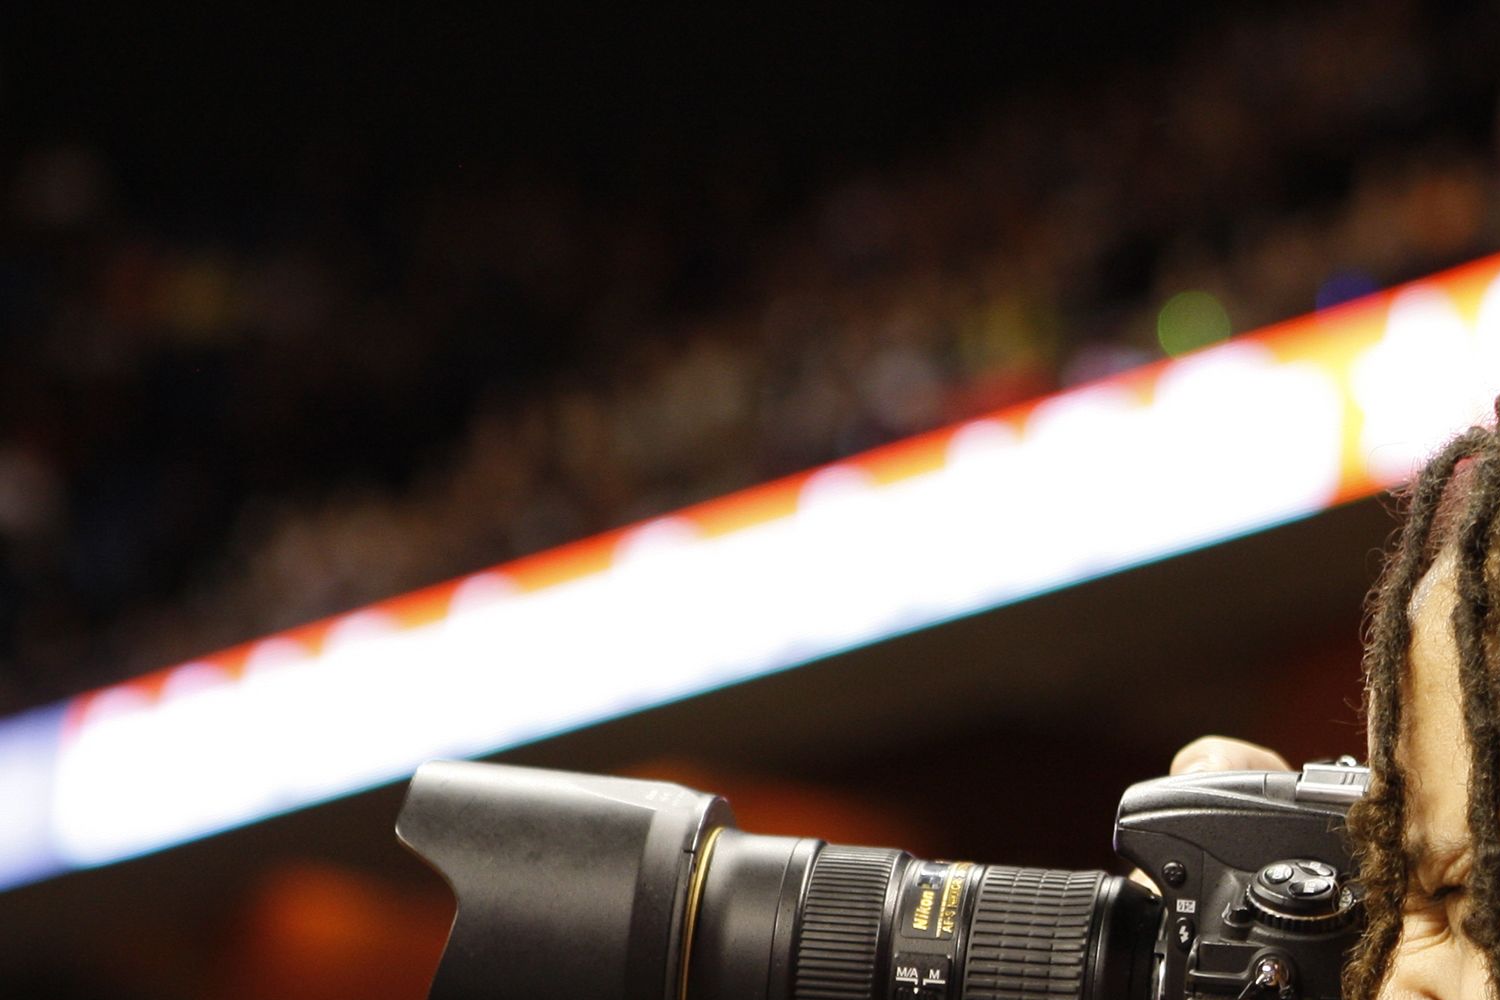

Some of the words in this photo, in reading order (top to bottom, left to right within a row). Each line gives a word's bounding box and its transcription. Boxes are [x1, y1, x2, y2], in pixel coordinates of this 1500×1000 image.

[912, 890, 935, 931] Nikon
[942, 910, 956, 934] AF-S
[896, 966, 918, 978] M/A
[929, 968, 940, 980] M
